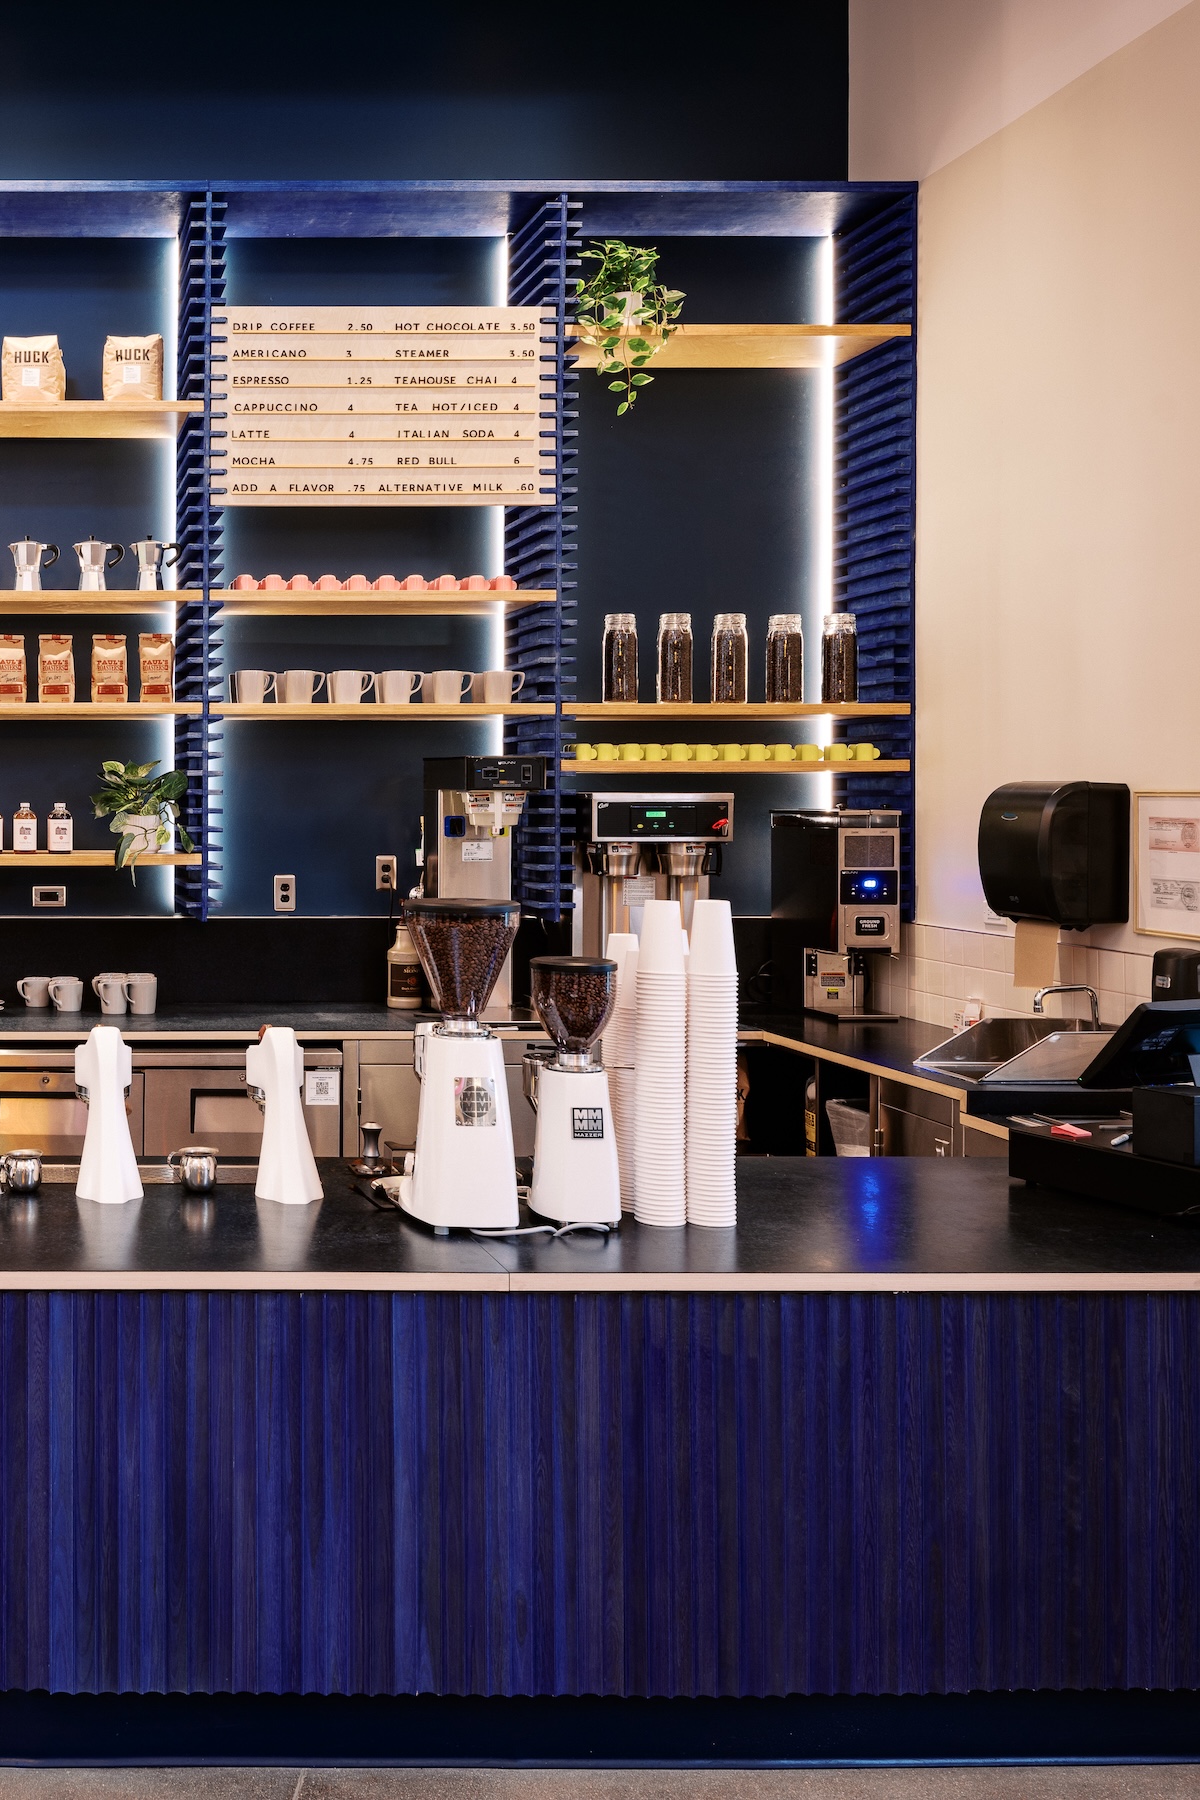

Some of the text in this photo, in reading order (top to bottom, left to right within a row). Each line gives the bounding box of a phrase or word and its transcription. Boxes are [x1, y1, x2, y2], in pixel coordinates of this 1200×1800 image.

[232, 322, 373, 331] DRIP COFFEE 2.50
[395, 322, 535, 331] HOT CHOCOLATE 3.50
[14, 350, 49, 364] HUCK
[115, 348, 151, 362] HUCK
[232, 349, 353, 358] AMERICANO 3
[395, 349, 535, 358] STEAMER 3.50
[232, 376, 373, 385] ESPRESSO 1.25
[394, 376, 518, 385] TEAHOUSE CHAI 4
[234, 403, 354, 412] CAPPUCCINO 4
[395, 403, 520, 412] TEA HOT/ICED 4
[231, 430, 355, 439] LATTE 4
[397, 429, 520, 438] ITALIAN SODA 4
[232, 456, 374, 465] MOCHA 4.75
[397, 456, 520, 465] RED BULL 6
[232, 483, 366, 492] ADD A FLAVOR .75
[378, 483, 535, 492] ALTERNATIVE MILK .60
